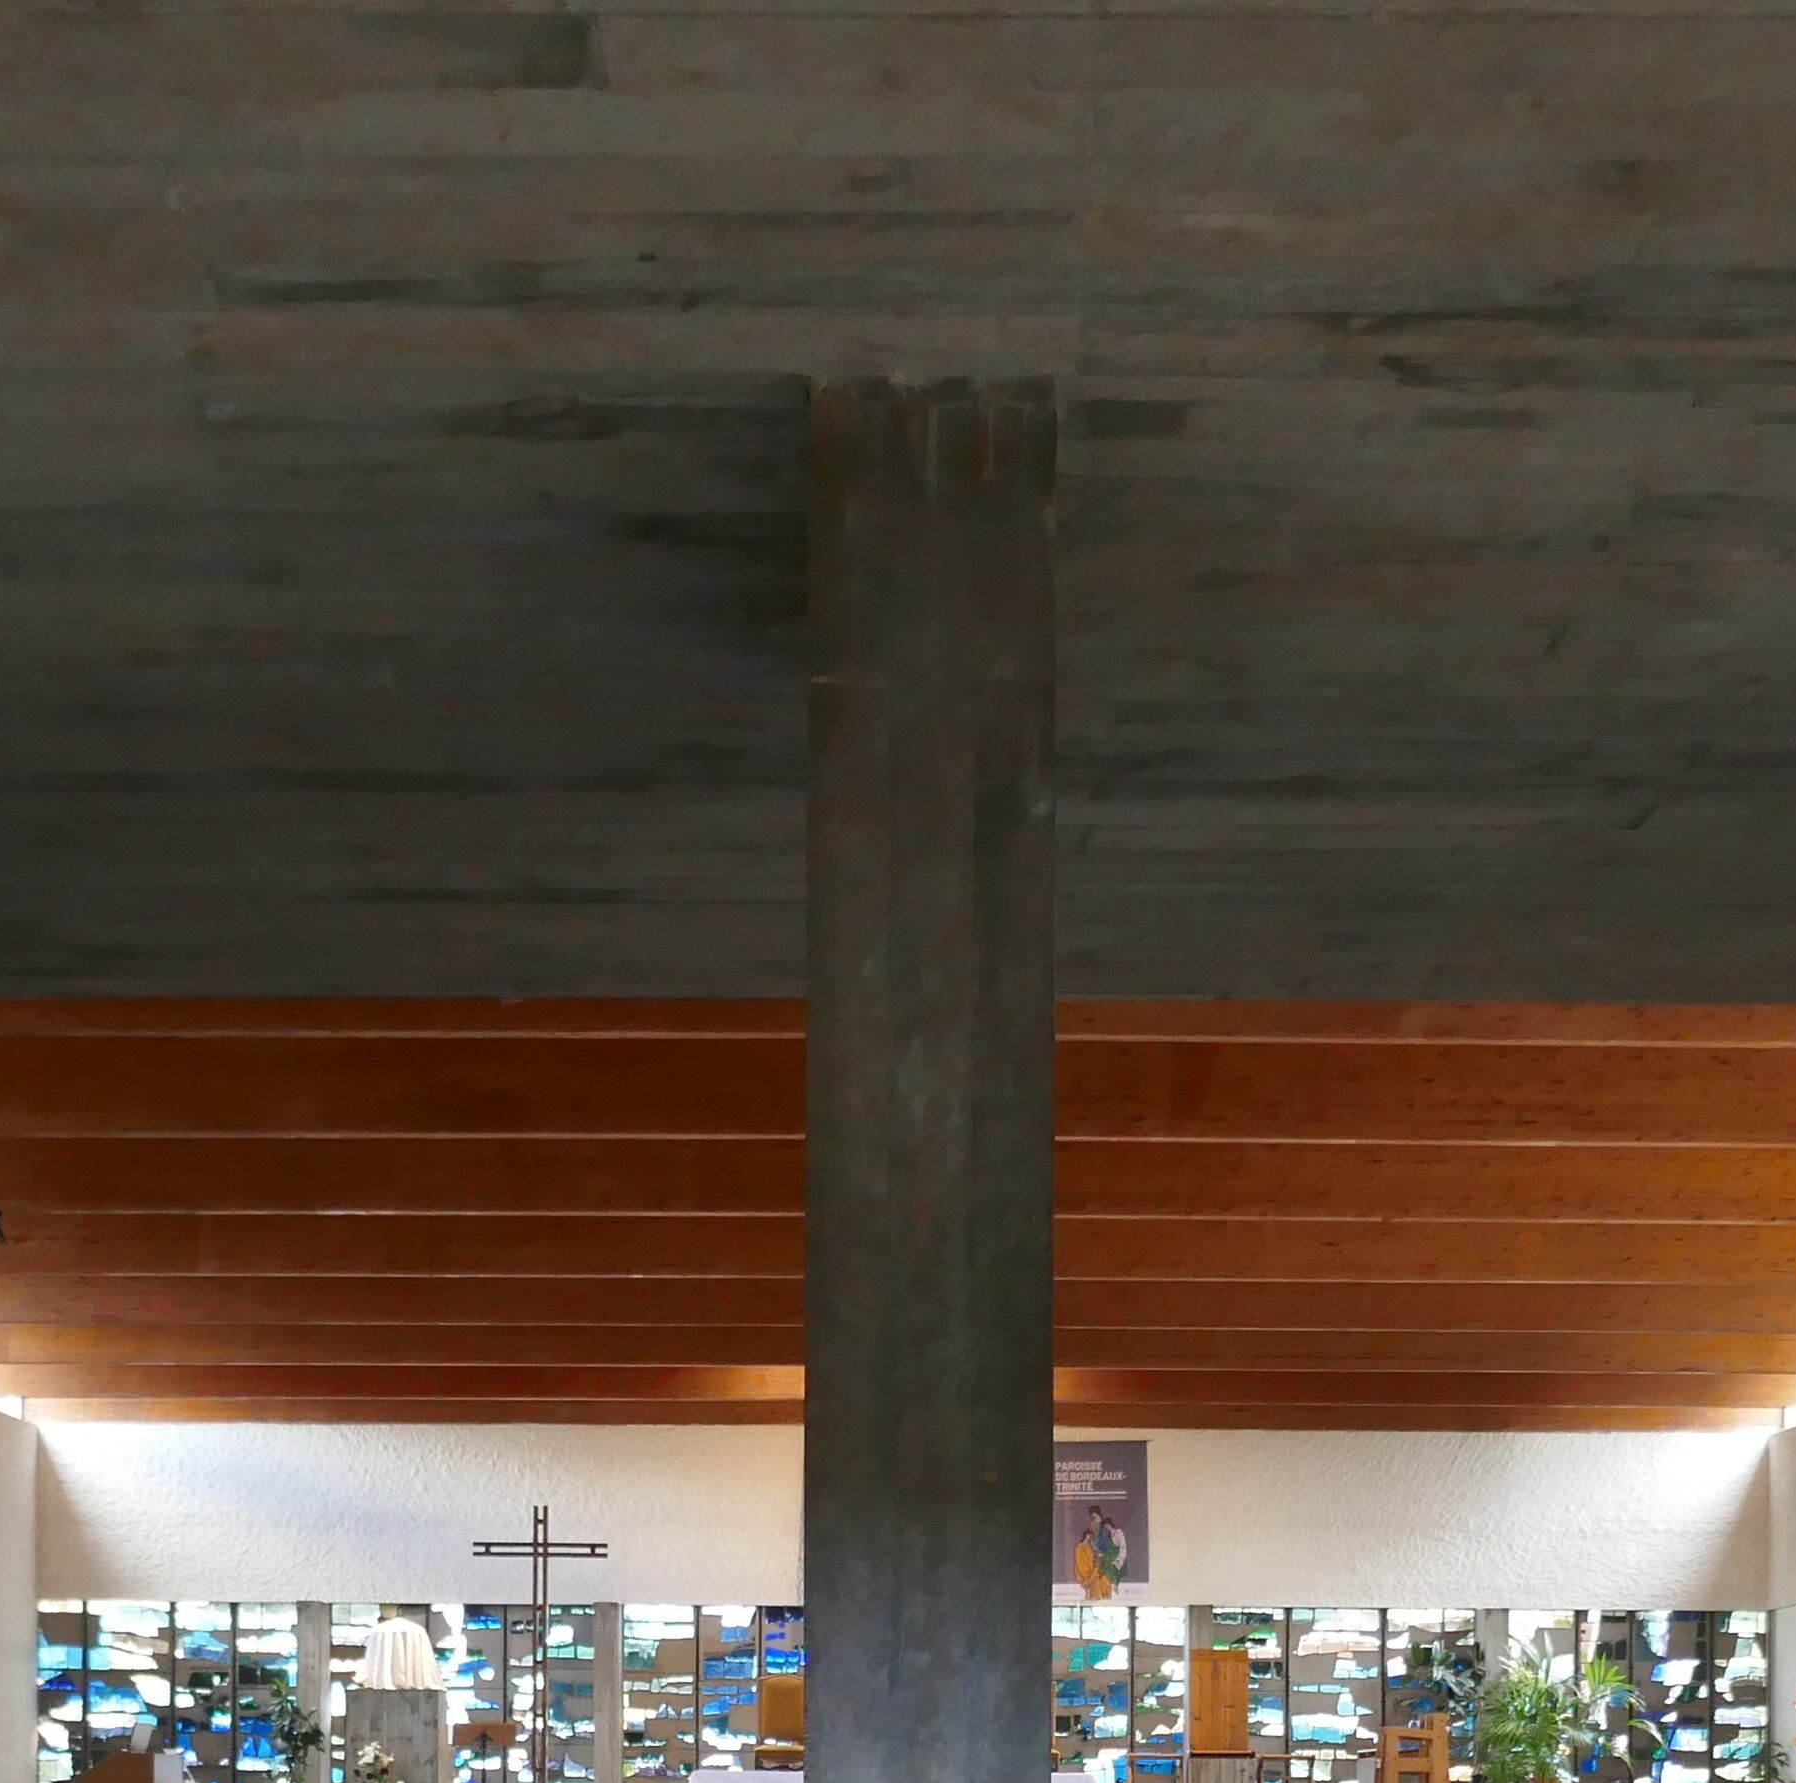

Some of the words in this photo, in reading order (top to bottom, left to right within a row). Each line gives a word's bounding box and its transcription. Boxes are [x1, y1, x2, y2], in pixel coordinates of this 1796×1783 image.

[1055, 1461, 1103, 1470] PAROISSE
[1055, 1472, 1069, 1481] DE
[1070, 1470, 1127, 1481] BORDEAUX-
[1056, 1481, 1093, 1491] TRINITÉ
